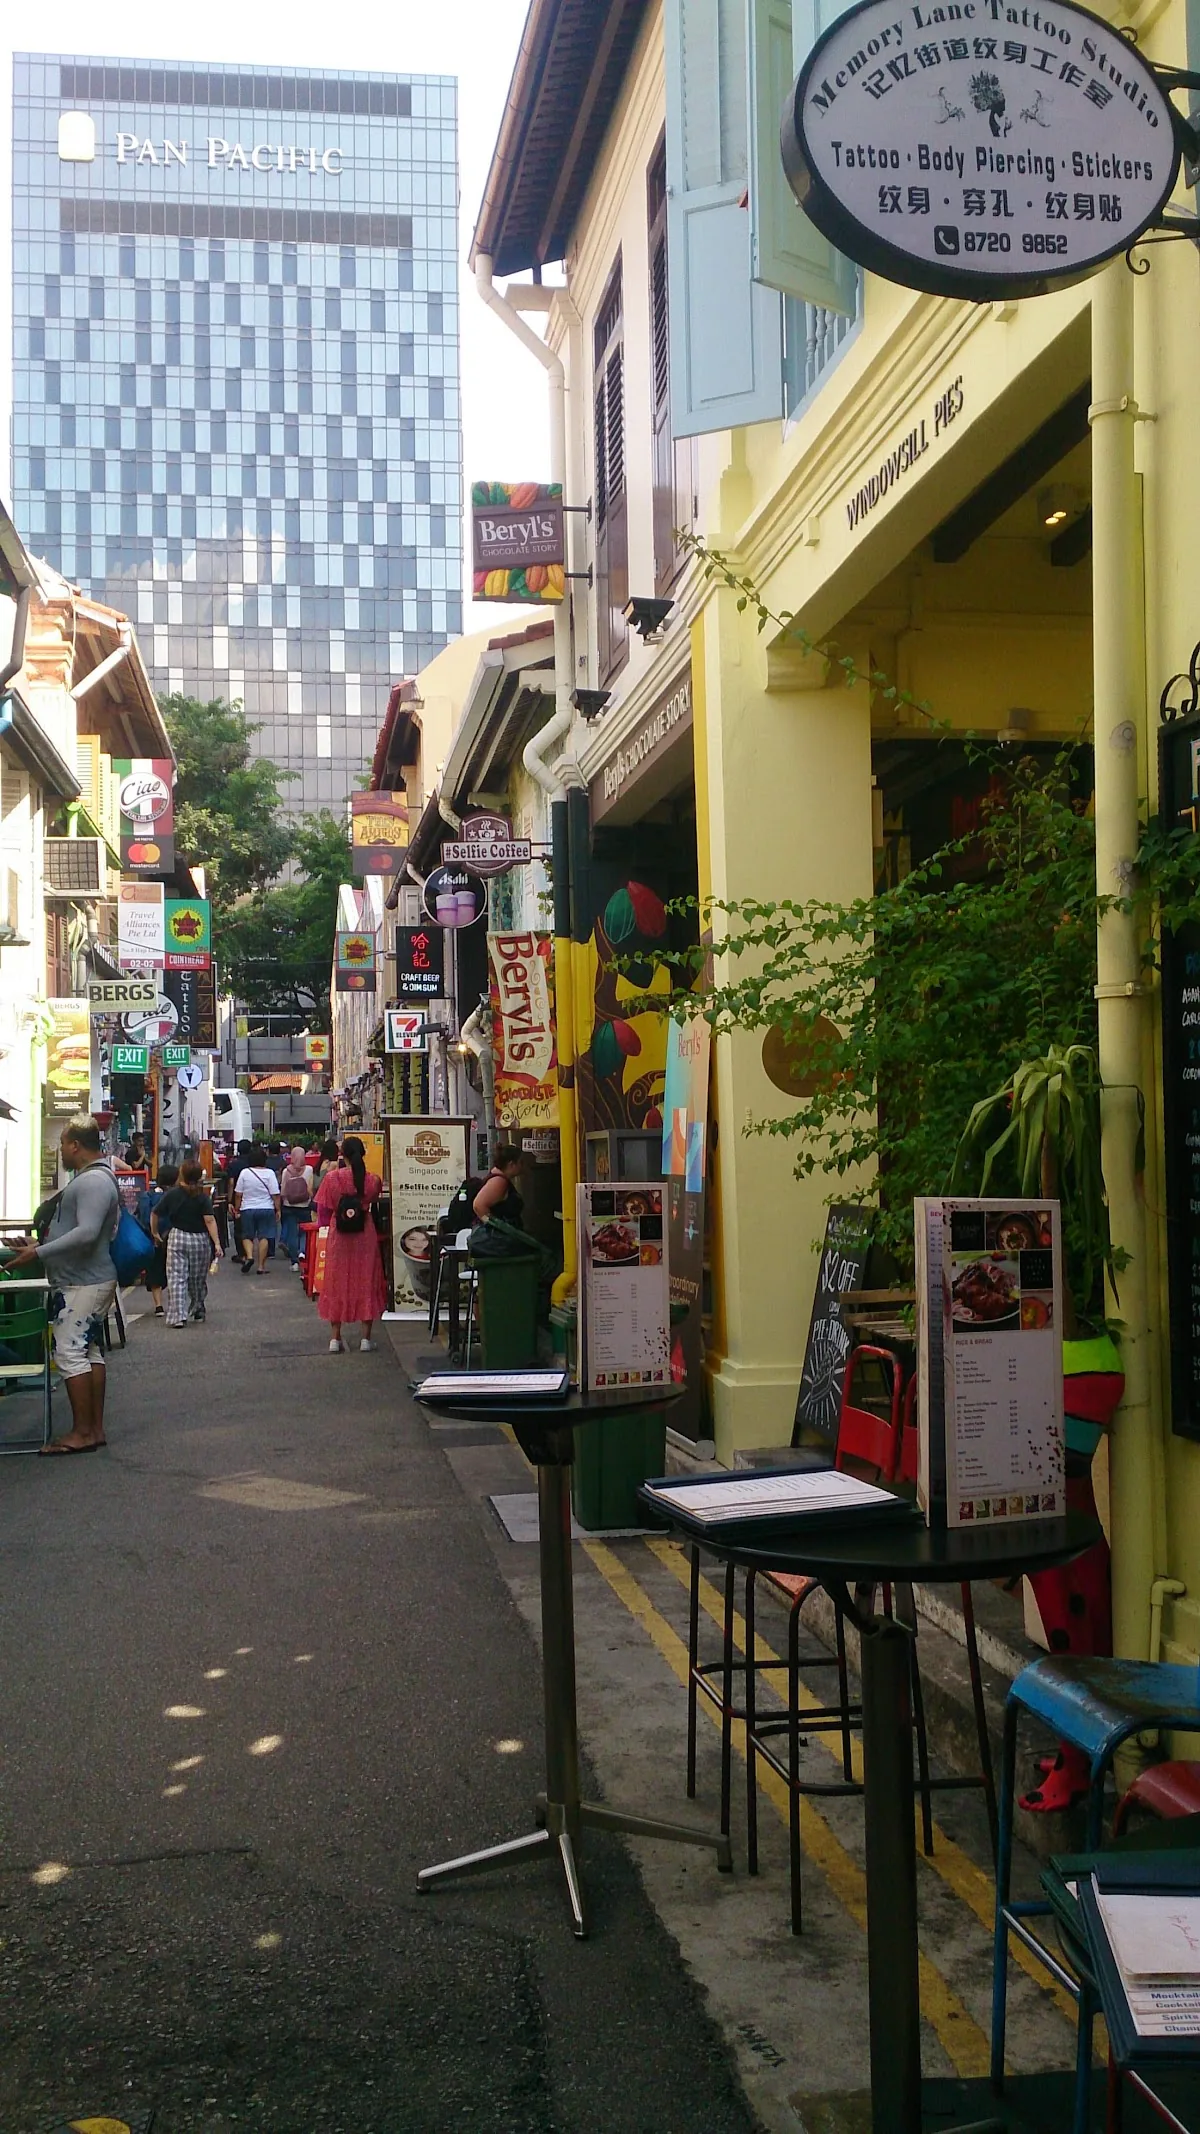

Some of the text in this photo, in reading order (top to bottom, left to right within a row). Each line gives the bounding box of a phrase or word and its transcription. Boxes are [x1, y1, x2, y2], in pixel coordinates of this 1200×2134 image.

[809, 0, 1159, 128] Memory Lane Tattoo Studio
[861, 37, 1114, 110] 记忆街道纹身工作室
[115, 132, 343, 175] PAN PACIFIC
[831, 141, 1153, 182] Tattoo Body Piercing Stickers
[964, 231, 1068, 254] 8720 9852
[846, 374, 964, 530] WINDOWSILL PIES
[478, 515, 554, 546] Beryl's
[482, 544, 557, 557] CHOCOLATE STORY
[666, 681, 691, 730] STORY
[121, 781, 161, 806] Ciao
[445, 844, 529, 859] #Selfie Coffee
[438, 873, 469, 885] Asahi
[129, 911, 155, 919] Travel
[143, 929, 157, 938] Ltd
[130, 960, 155, 968] 02-02
[400, 973, 440, 982] CRAFT BEER
[402, 983, 438, 992] & DIM SUM
[88, 984, 155, 1001] BERGS
[180, 970, 192, 1033] Tattoo
[496, 934, 546, 1062] Beryl's
[117, 1048, 144, 1062] EXIT
[166, 1048, 186, 1059] EXIT
[502, 1101, 551, 1123] Story
[408, 1167, 449, 1176] Singapore
[399, 1183, 459, 1191] #Selfie Coffee
[821, 1248, 860, 1293] $2 OFF
